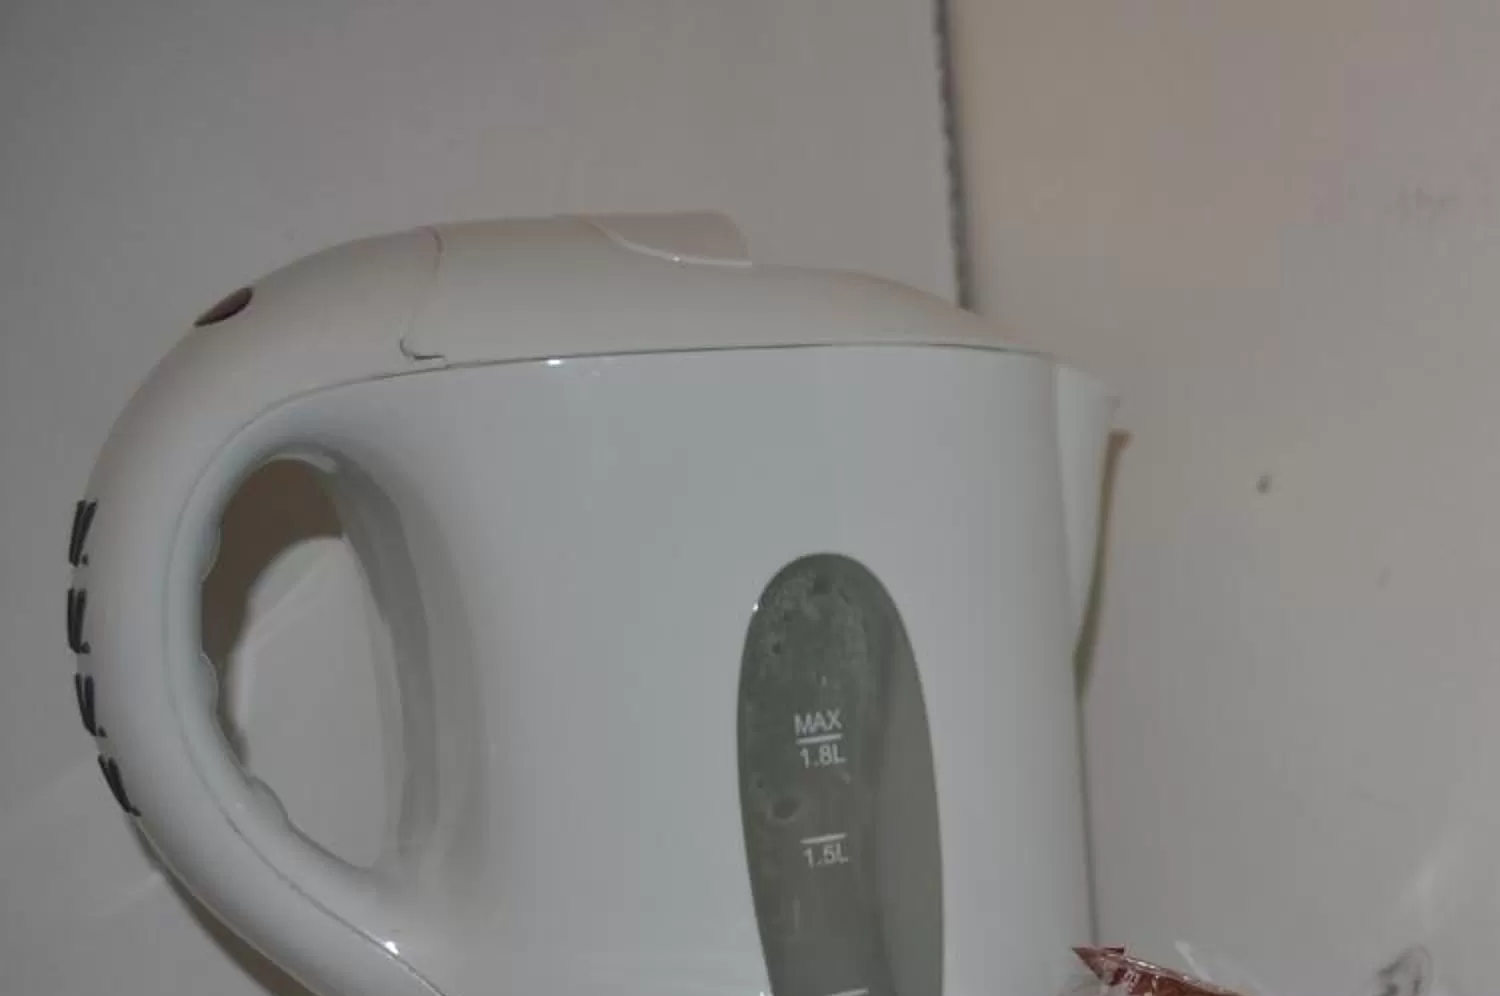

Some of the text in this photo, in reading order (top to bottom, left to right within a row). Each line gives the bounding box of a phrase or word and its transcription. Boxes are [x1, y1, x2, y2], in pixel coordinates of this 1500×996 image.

[794, 709, 843, 735] MAX
[799, 742, 847, 769] 1.8L
[803, 842, 849, 868] 1.5L
